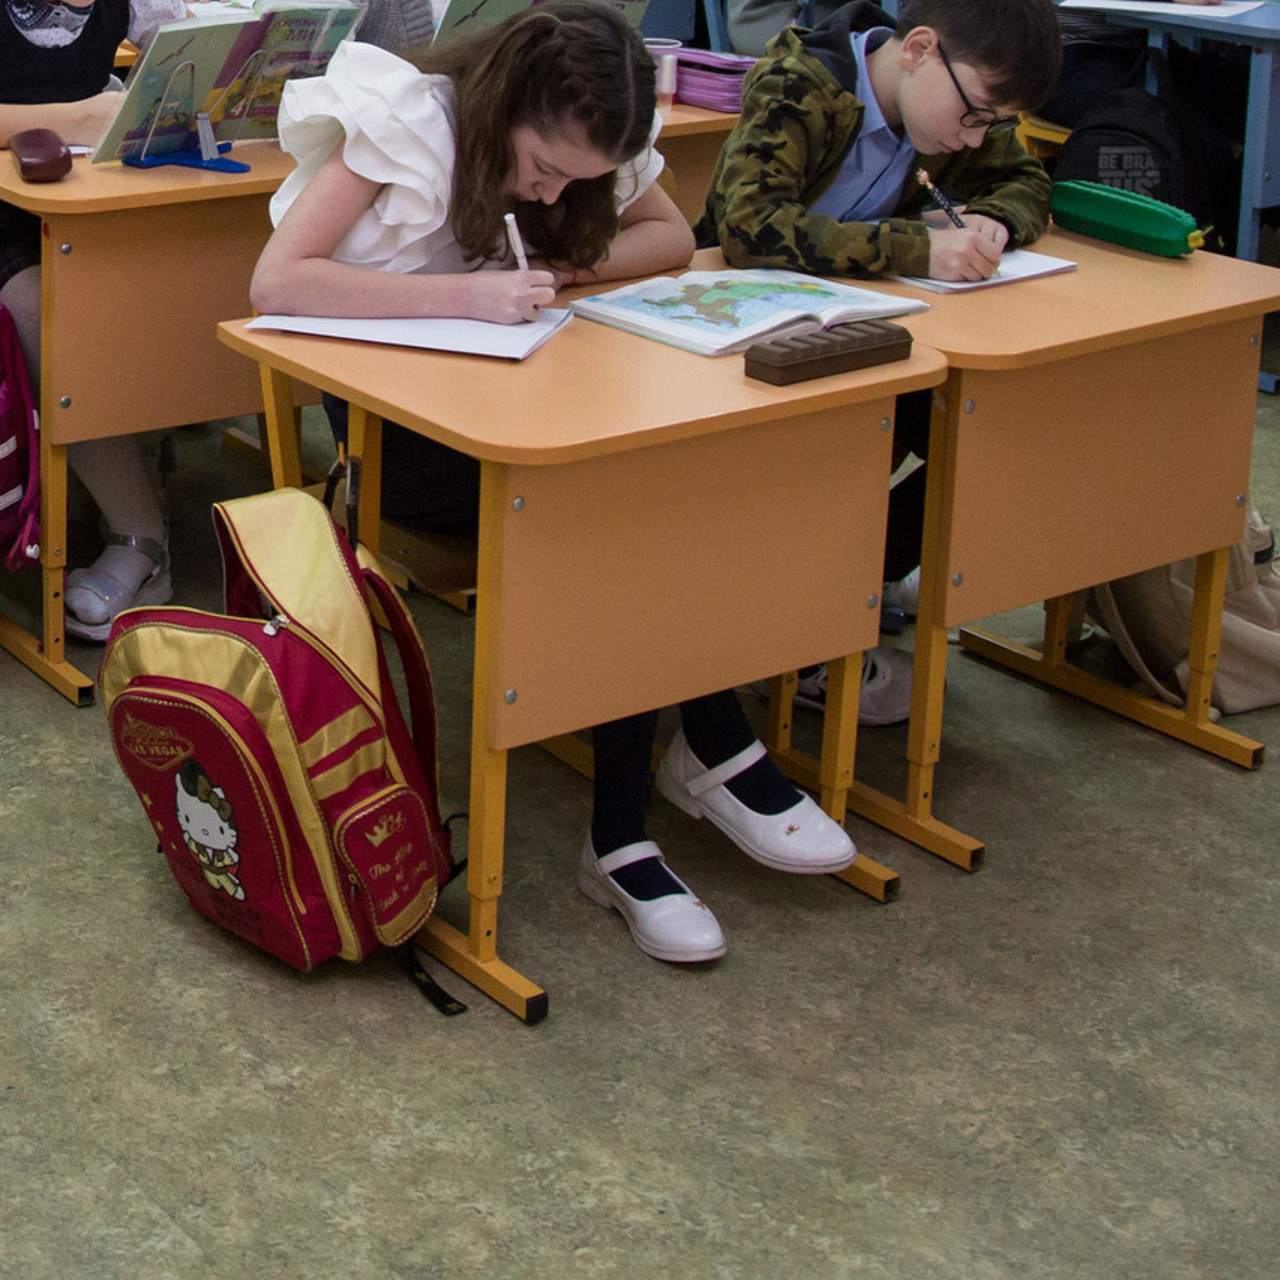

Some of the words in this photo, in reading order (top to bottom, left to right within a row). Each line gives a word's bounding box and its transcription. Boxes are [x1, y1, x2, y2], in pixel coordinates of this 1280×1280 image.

[286, 28, 320, 41] МИ
[231, 98, 246, 116] 4
[1099, 154, 1118, 169] BE
[1123, 154, 1159, 169] BRA
[148, 745, 184, 756] VEGAS
